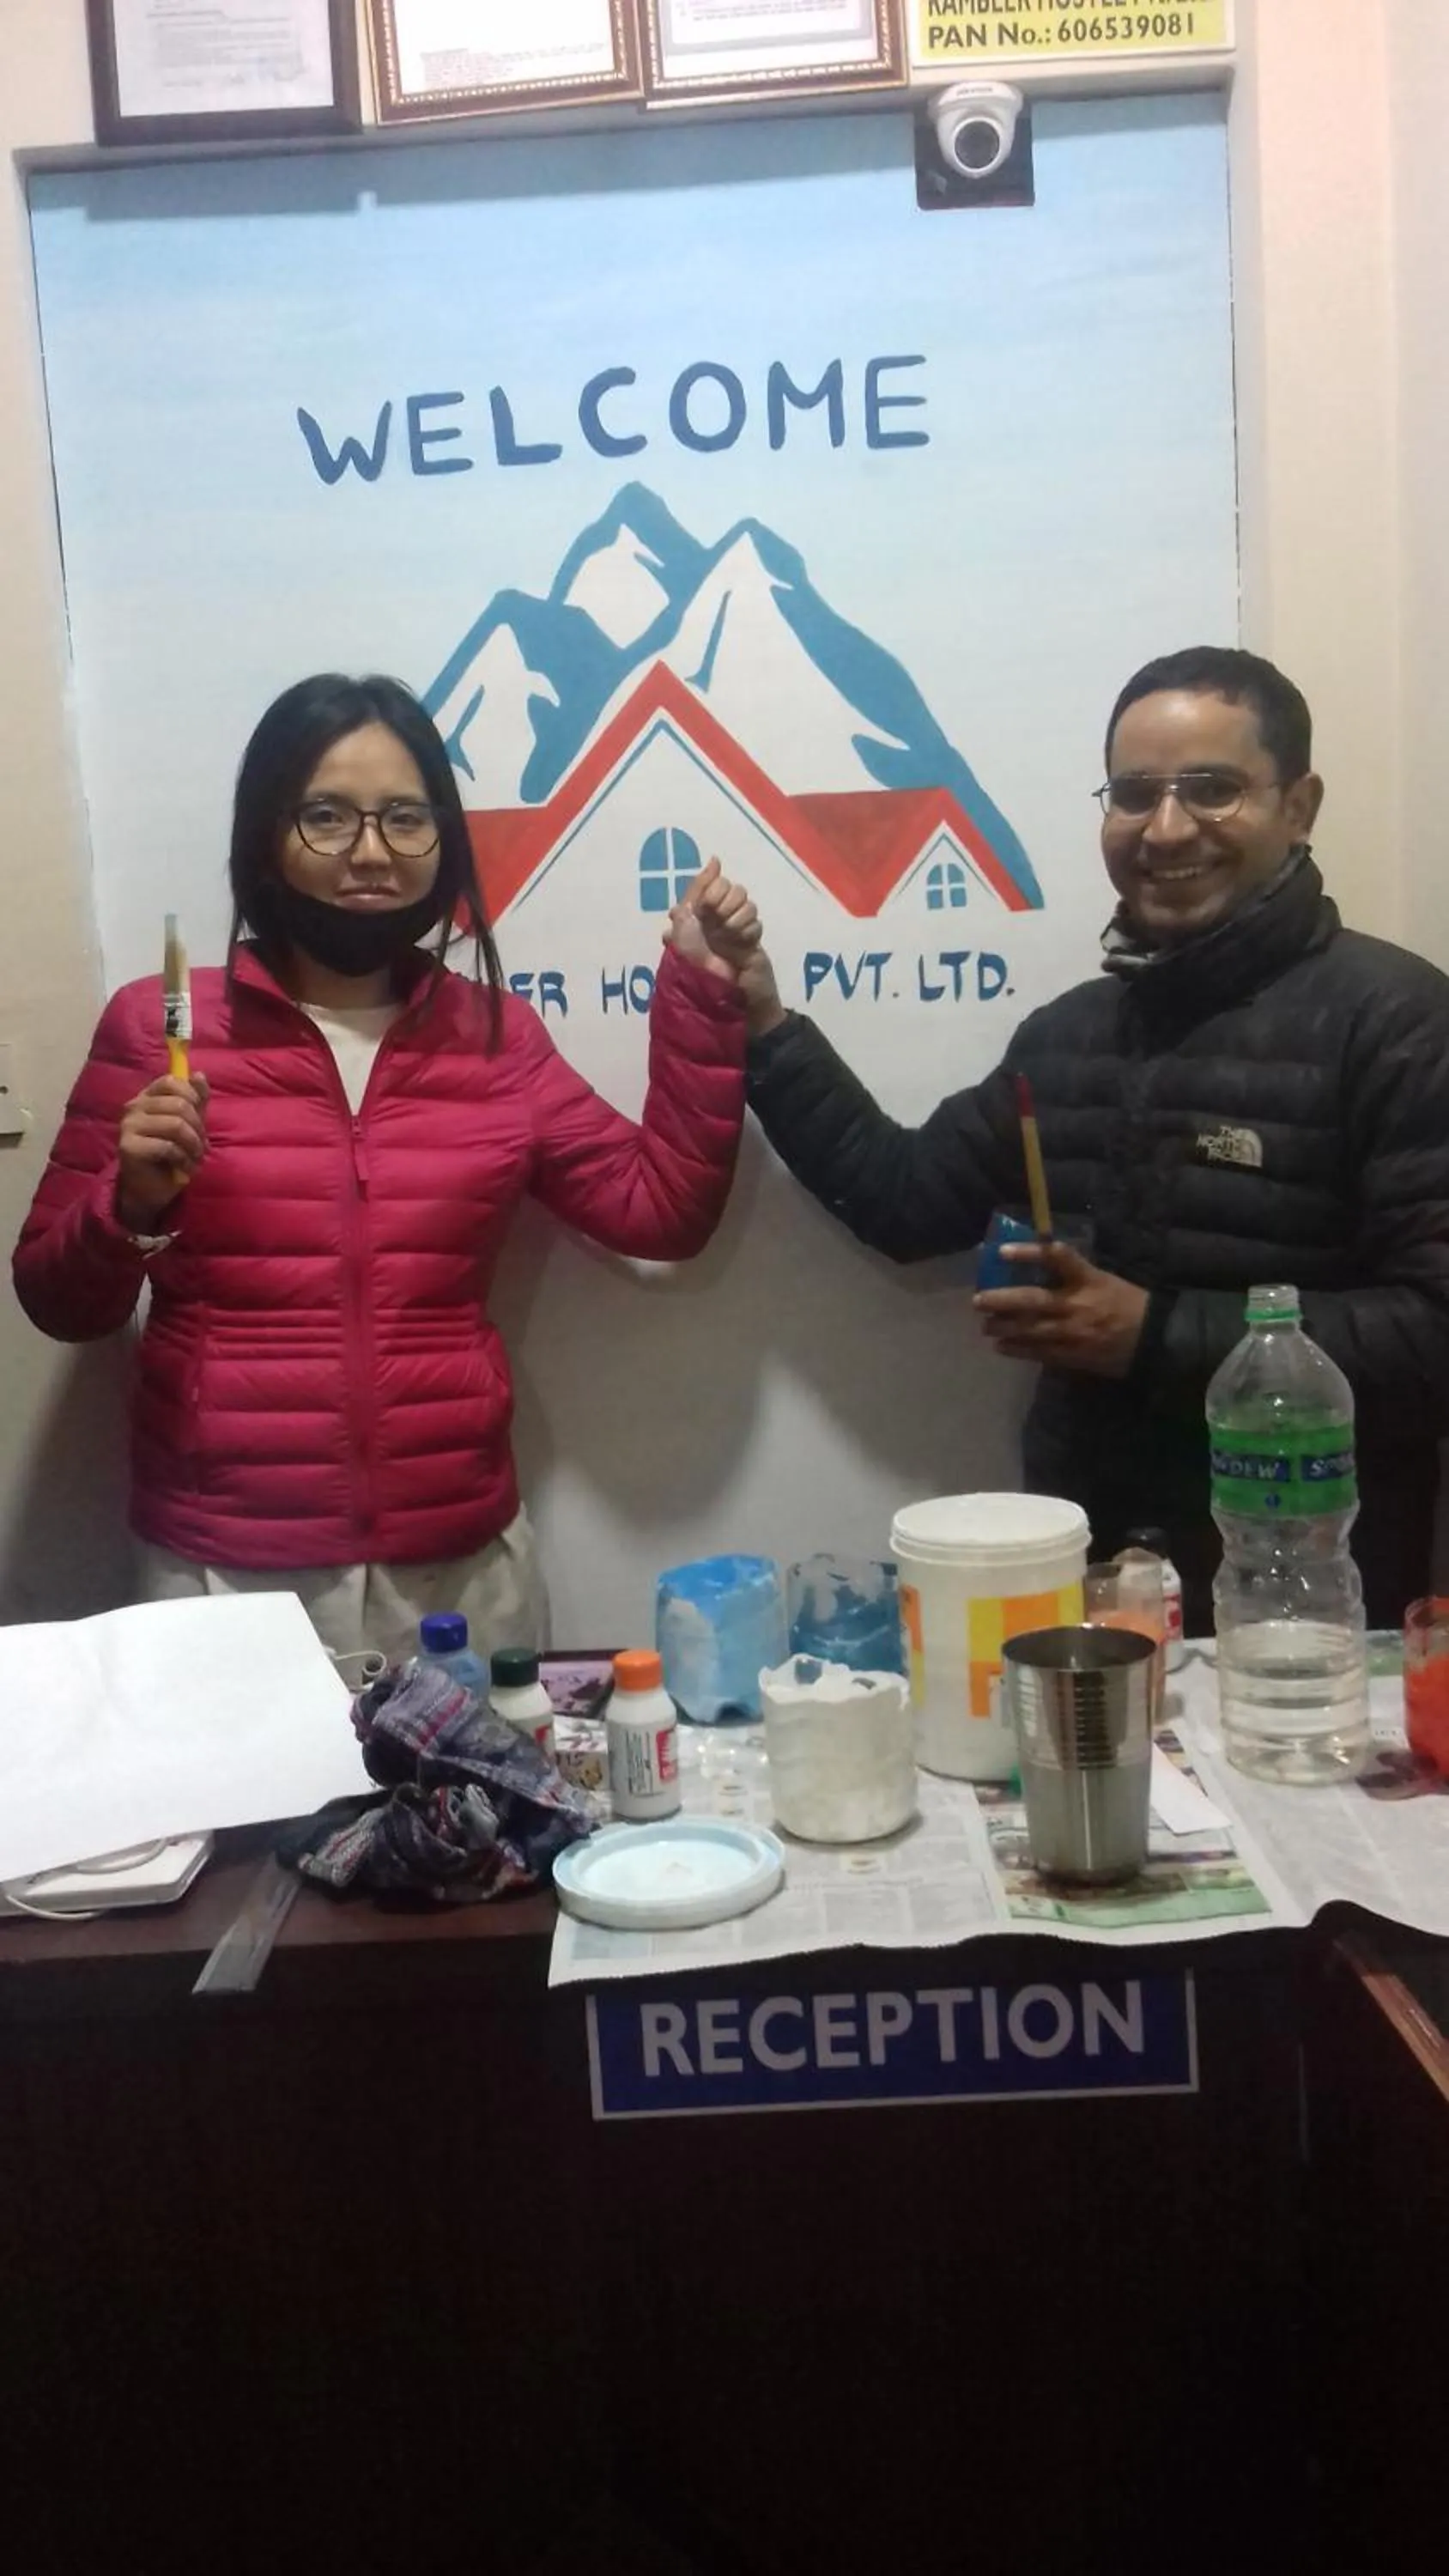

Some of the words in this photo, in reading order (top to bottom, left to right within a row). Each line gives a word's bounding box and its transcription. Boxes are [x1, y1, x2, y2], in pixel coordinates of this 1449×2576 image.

[928, 25, 986, 49] PAN
[1058, 13, 1194, 43] 606539081
[297, 355, 930, 484] WELCOME
[803, 952, 900, 1003] PVT.
[919, 951, 1016, 1002] LTD.
[640, 1980, 1145, 2077] RECEPTION
